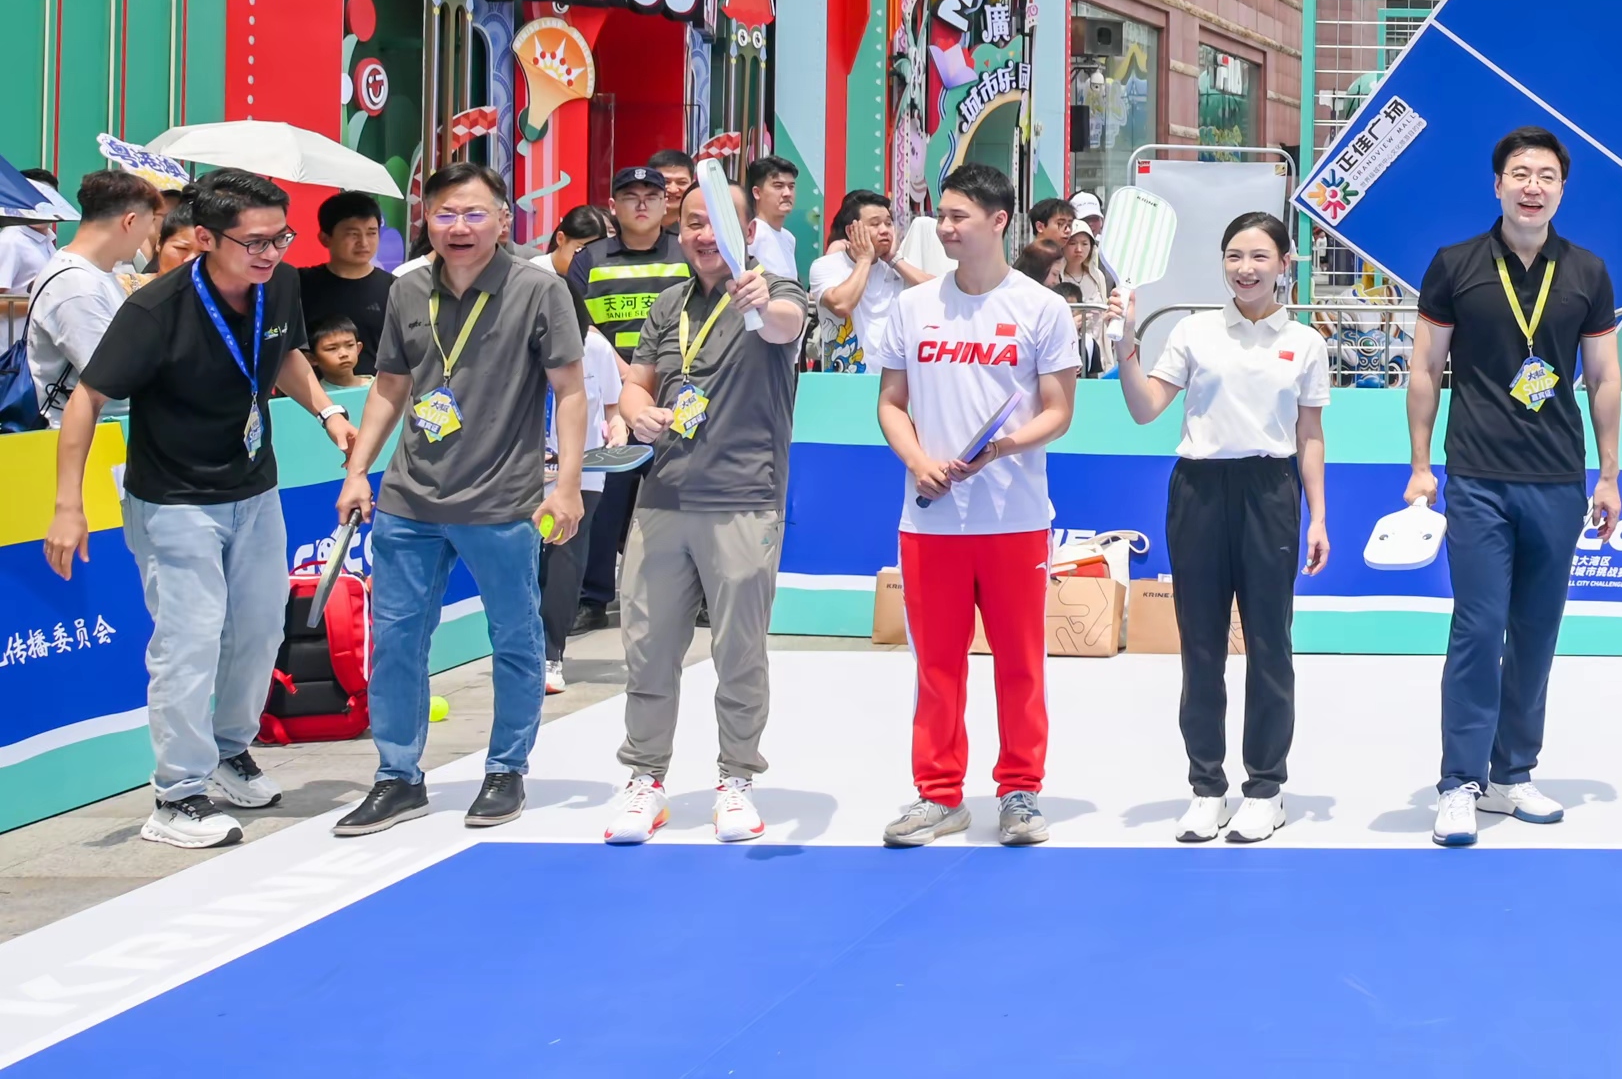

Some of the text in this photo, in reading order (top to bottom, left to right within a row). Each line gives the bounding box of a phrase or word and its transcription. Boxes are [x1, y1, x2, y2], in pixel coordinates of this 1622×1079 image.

[982, 3, 1010, 43] 廣
[960, 60, 1031, 133] 城市乐园
[1336, 99, 1407, 173] 正佳广场
[1352, 113, 1416, 181] GRANDVIEW MALL
[917, 340, 1018, 367] CHINA
[1522, 377, 1554, 397] SVIP
[419, 406, 450, 426] SVIP
[0, 614, 117, 668] 传播委员会
